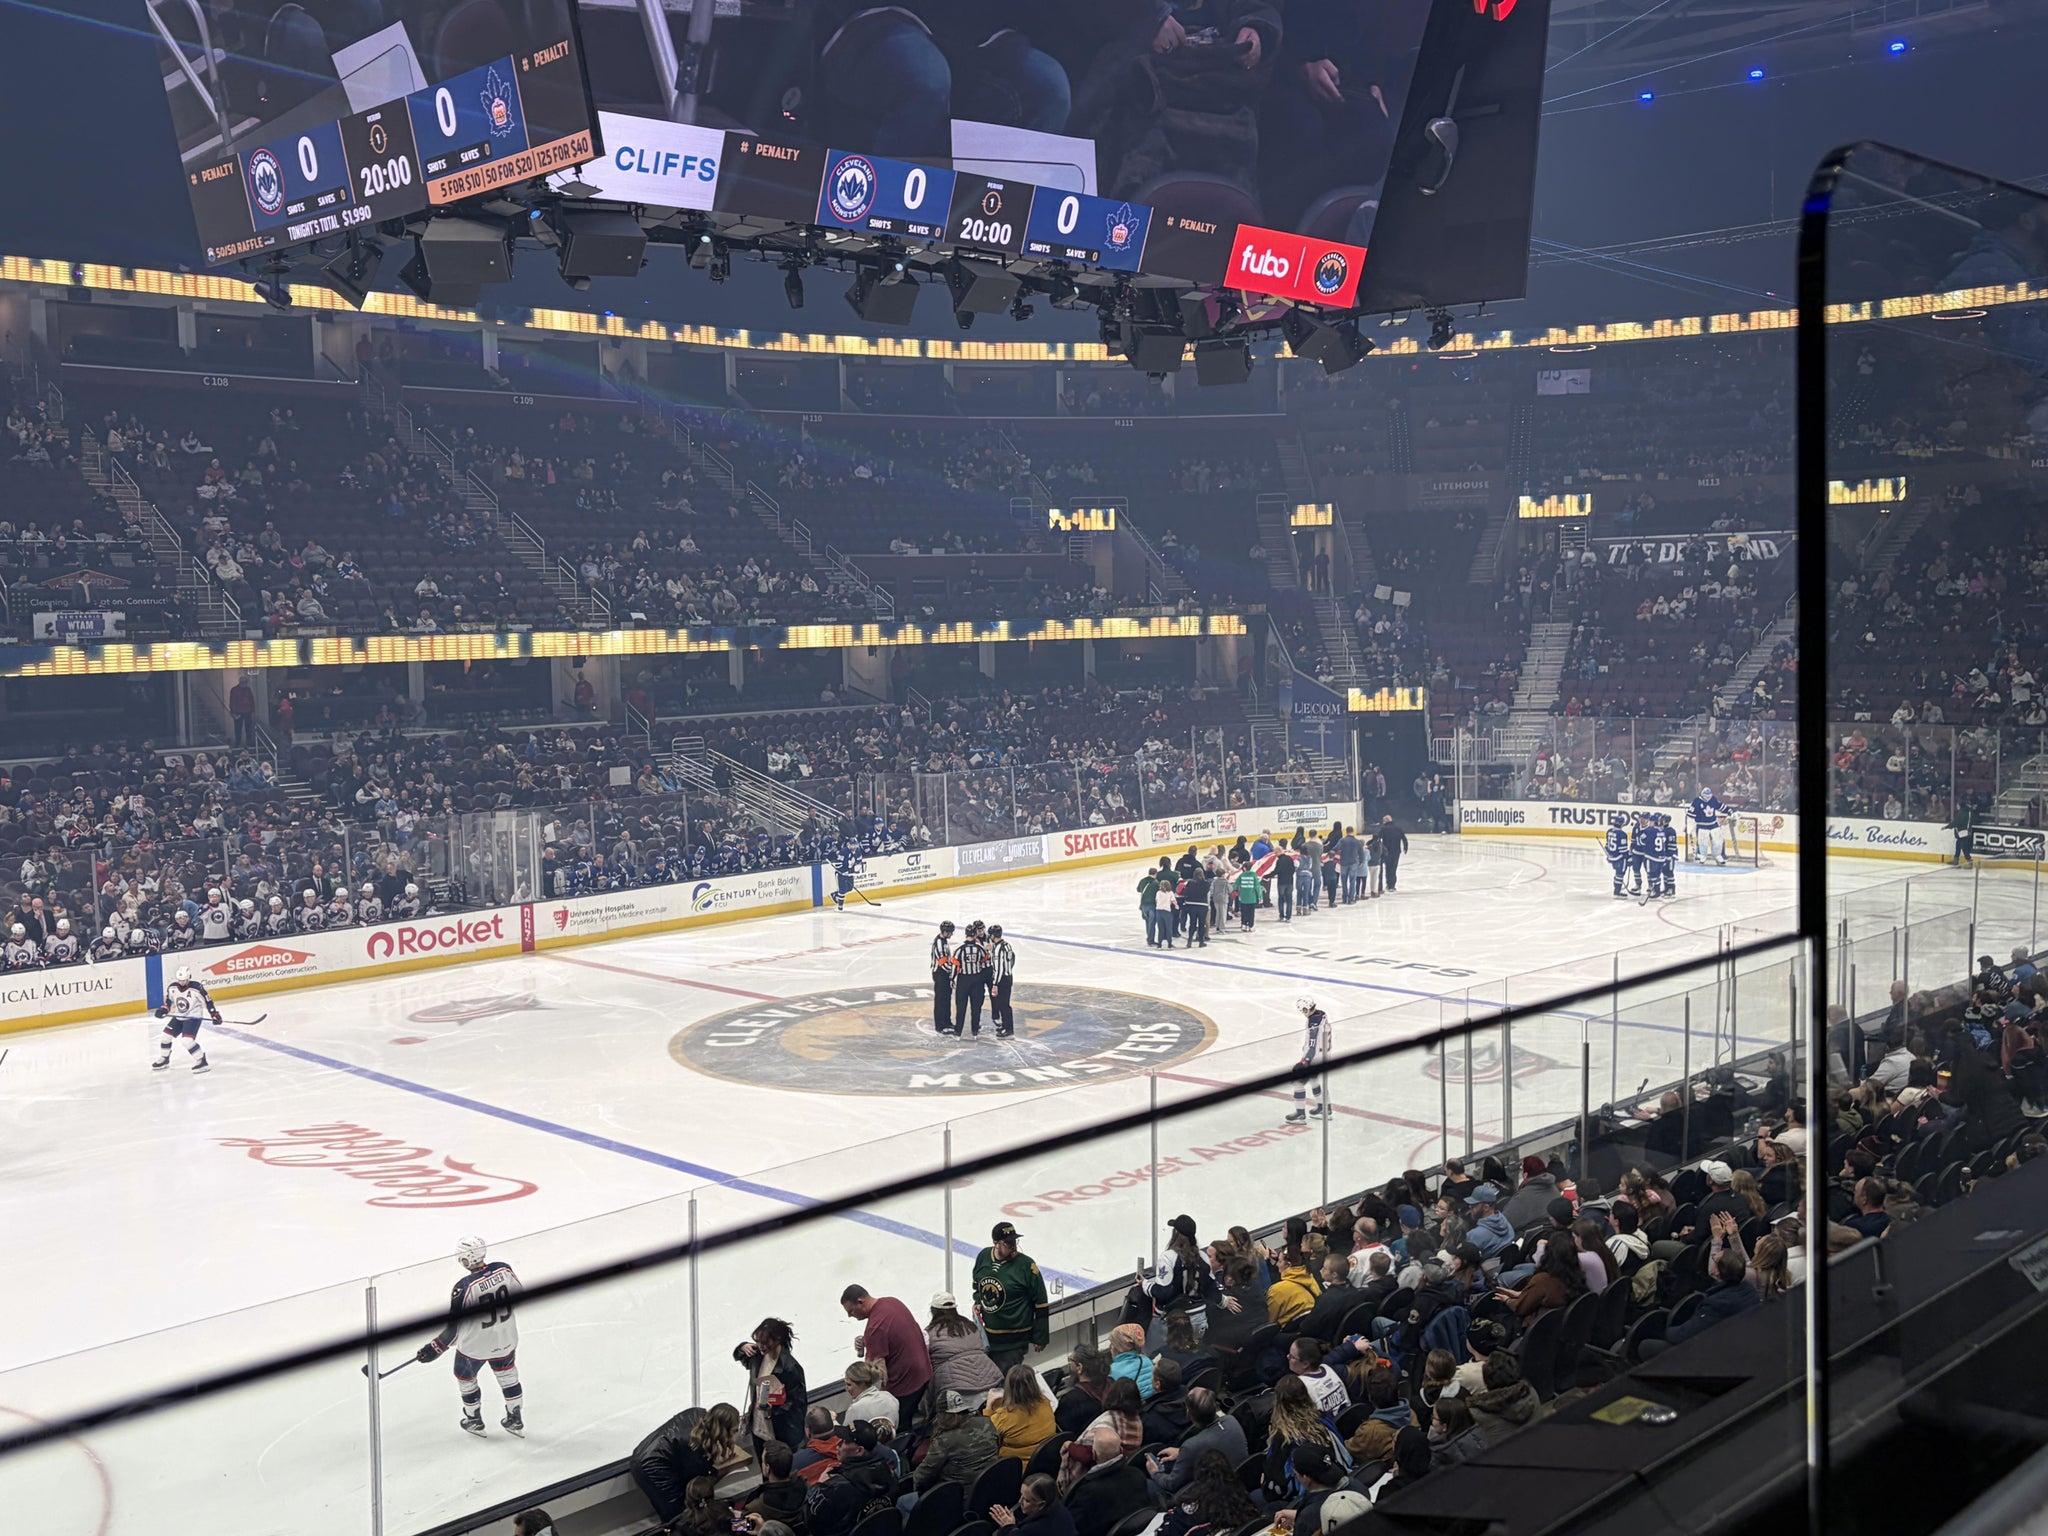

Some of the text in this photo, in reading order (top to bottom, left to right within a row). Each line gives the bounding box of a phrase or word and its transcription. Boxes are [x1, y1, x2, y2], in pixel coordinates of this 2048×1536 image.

[533, 40, 569, 67] PENALTY
[435, 87, 457, 137] 0
[375, 133, 381, 145] 1
[298, 136, 318, 182] 0
[460, 143, 491, 163] SAVES 0
[755, 143, 800, 161] PENALTY
[201, 162, 234, 182] PENALTY
[251, 152, 277, 175] CLEVELAND
[426, 158, 447, 174] SHOTS
[440, 136, 588, 197] 5 FOR $10 50 FOR $20 125 FOR $40
[615, 146, 716, 182] CLIFFS
[835, 159, 873, 182] CLEVELAND
[360, 155, 411, 197] 20:00
[987, 182, 1004, 190] PERIOD
[317, 189, 346, 206] SAVES 0
[903, 168, 927, 210] 0
[286, 202, 305, 215] SHOTS
[832, 199, 867, 218] MONSTERS
[989, 198, 995, 208] 1
[287, 219, 319, 240] TONIGHT'S
[319, 214, 340, 233] TOTAL
[342, 205, 371, 226] $1,990
[869, 218, 891, 229] SHOTS
[1057, 195, 1080, 235] 0
[908, 224, 941, 238] SAVES 0
[959, 217, 1012, 245] 20:00
[1179, 218, 1217, 234] PENALTY
[215, 244, 237, 258] 50/50
[237, 236, 264, 253] RAFFLE
[1029, 242, 1051, 253] SHOTS
[1065, 248, 1098, 261] SAVES 0
[1240, 244, 1290, 278] fubo
[1320, 253, 1346, 268] CLEVELAND
[1316, 280, 1339, 294] MONSTERS
[1433, 481, 1489, 490] LITEHOUSE
[67, 620, 94, 631] WTAM
[1294, 702, 1341, 715] LECOM
[1171, 819, 1215, 835] drug mart
[1064, 825, 1138, 856] SEATGEEK
[962, 841, 1040, 864] CLEVELAND MONSTERS
[758, 876, 800, 888] Bank Boldly
[714, 887, 757, 901] CENTURY
[758, 887, 792, 899] Live Fully
[570, 903, 635, 918] University Hospitals
[397, 913, 503, 956] Rocket
[1265, 946, 1478, 977] CLIFFS
[43, 978, 112, 998] MUTUAL
[907, 1022, 1182, 1088] MONSTERS
[1040, 1122, 1312, 1205] Rocket Arena
[479, 1272, 505, 1292] BUTCHER
